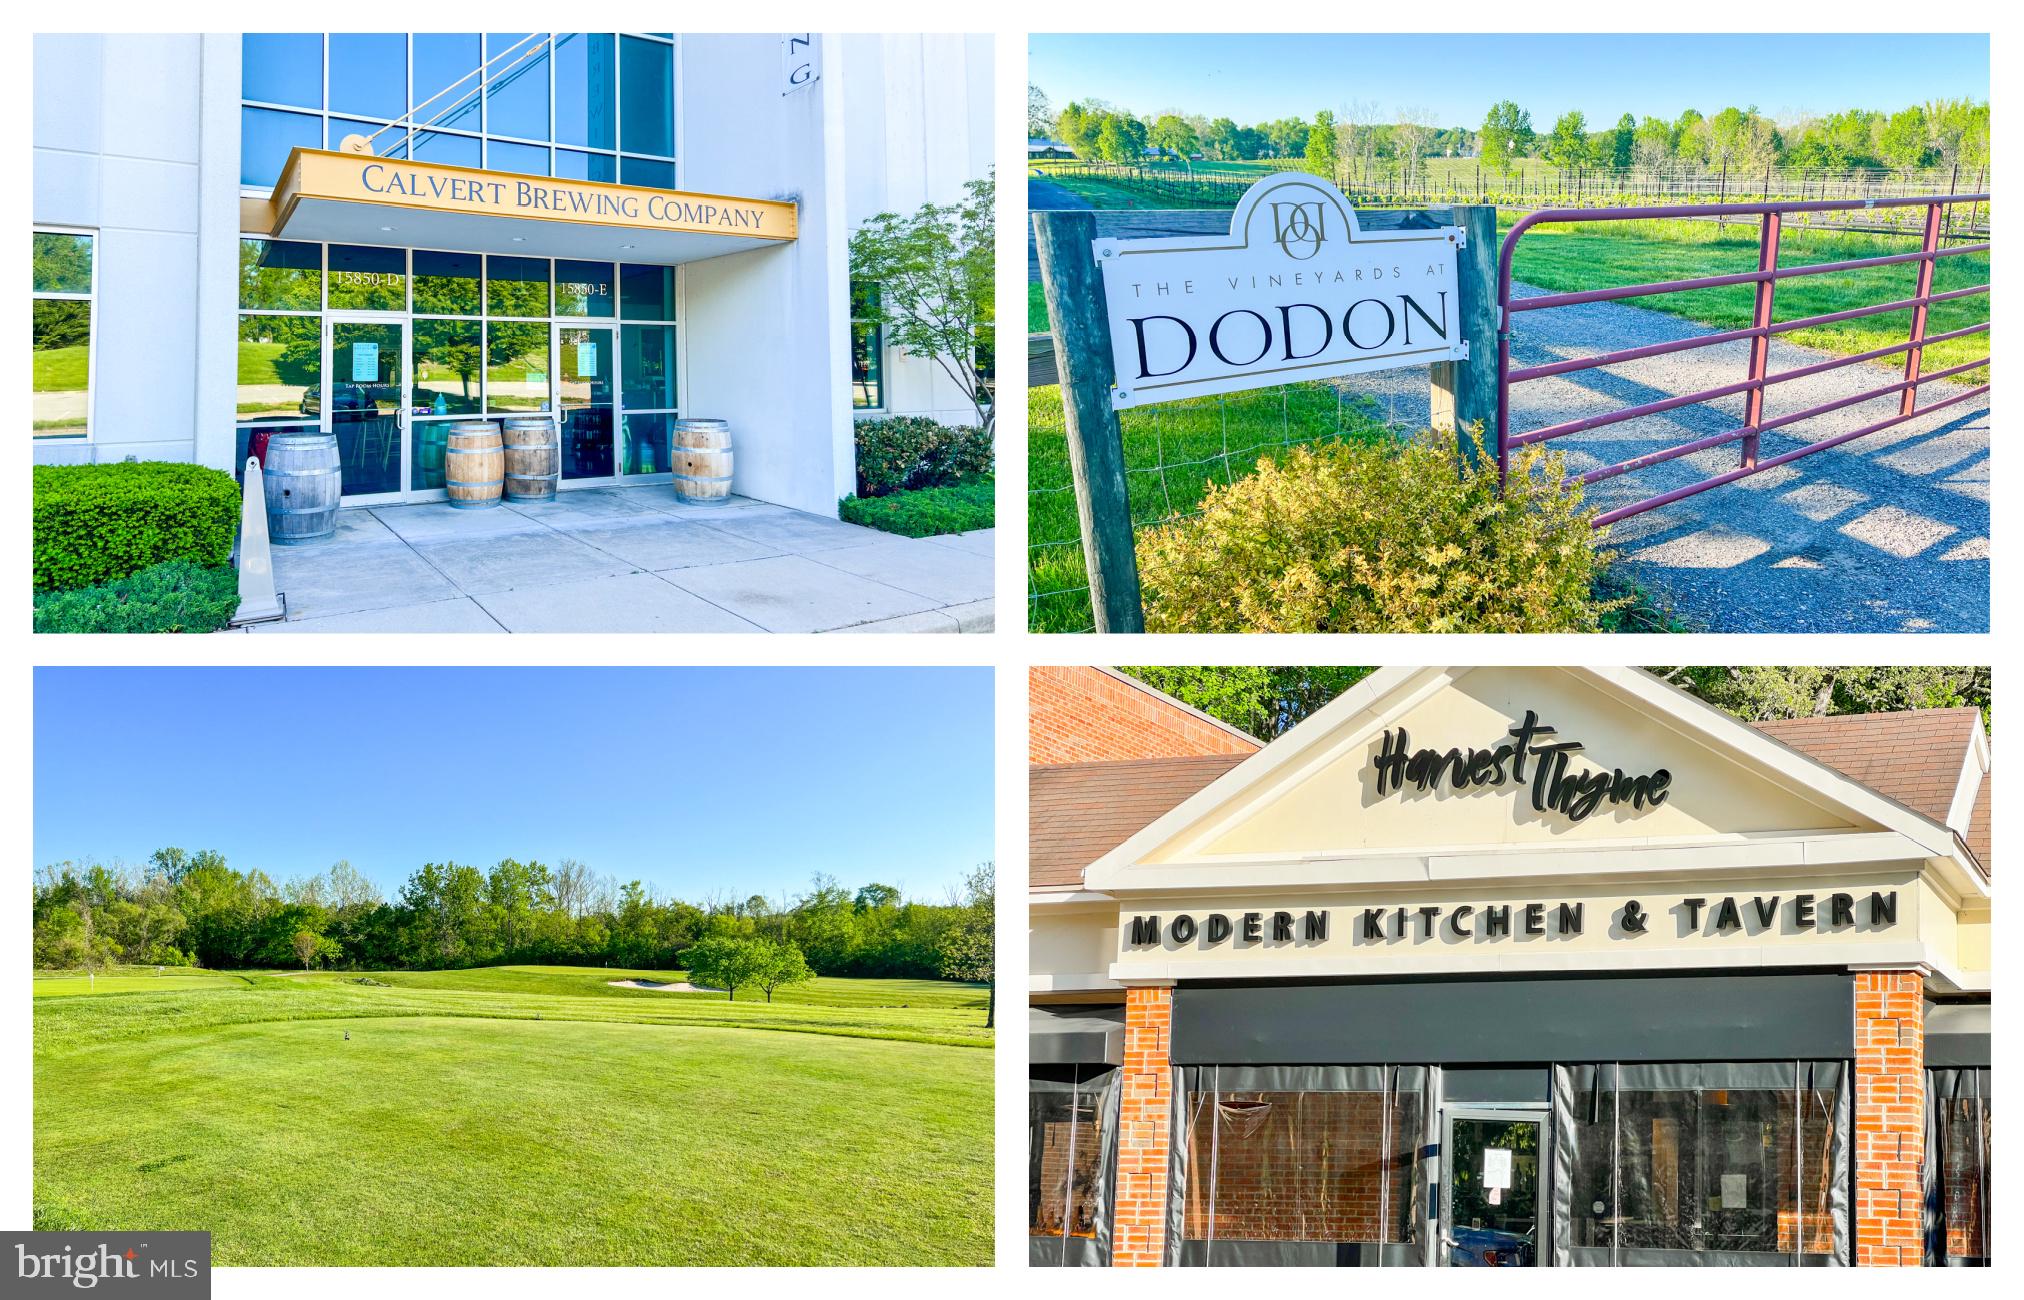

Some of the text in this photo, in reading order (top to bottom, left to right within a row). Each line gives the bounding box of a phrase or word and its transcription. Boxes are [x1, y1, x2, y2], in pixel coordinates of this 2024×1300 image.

[362, 164, 765, 229] CALVERT BREWING COMPANY
[337, 271, 400, 286] 15850-D
[561, 282, 608, 296] 15850-E
[1132, 263, 1446, 298] THE VINEYARDS AT
[1126, 291, 1448, 380] DODON
[1374, 709, 1673, 822] Harvest Thyme
[1131, 891, 1898, 946] MODERN KITCHEN & TAVERN
